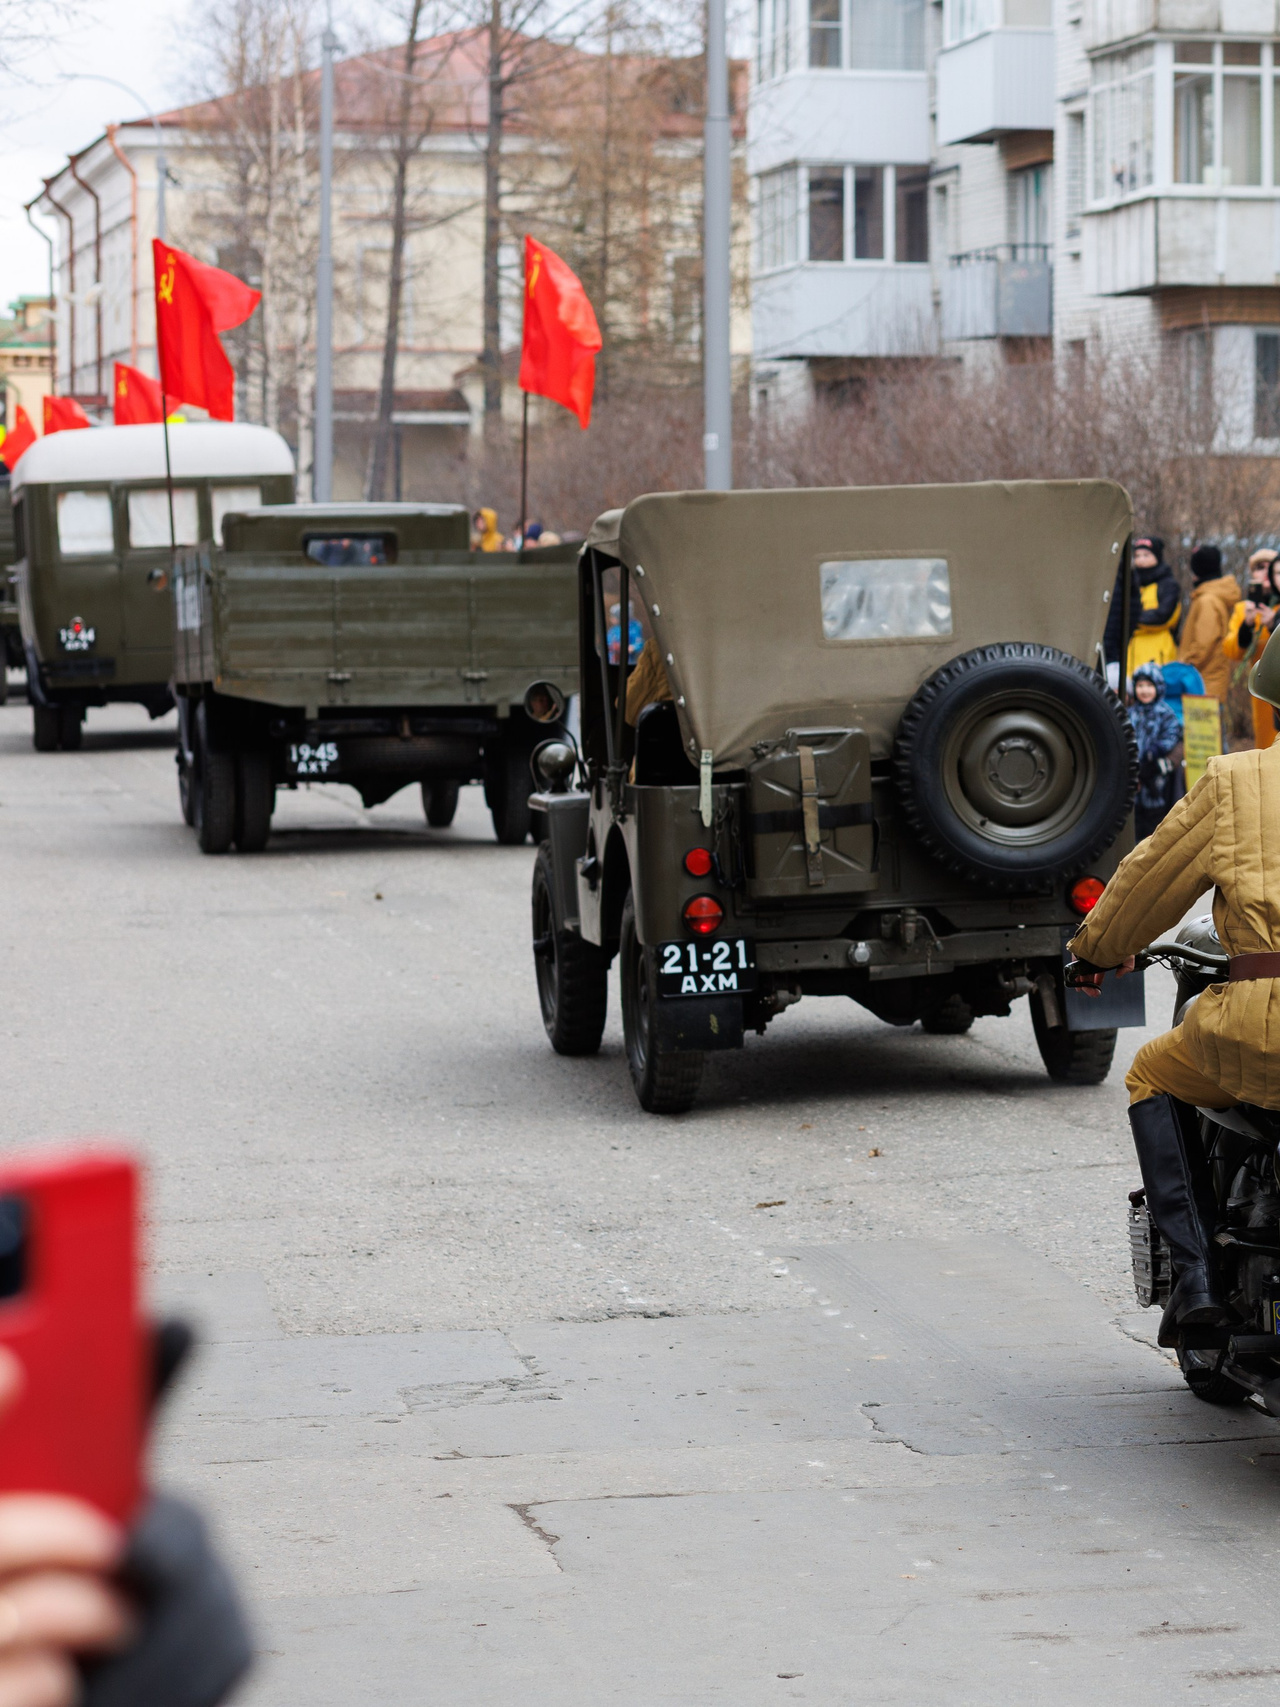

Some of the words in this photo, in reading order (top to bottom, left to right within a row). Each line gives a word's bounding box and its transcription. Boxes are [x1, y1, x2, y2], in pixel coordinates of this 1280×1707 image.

[297, 760, 331, 774] АХТ
[663, 939, 748, 974] 21-21
[681, 972, 738, 994] АХМ
